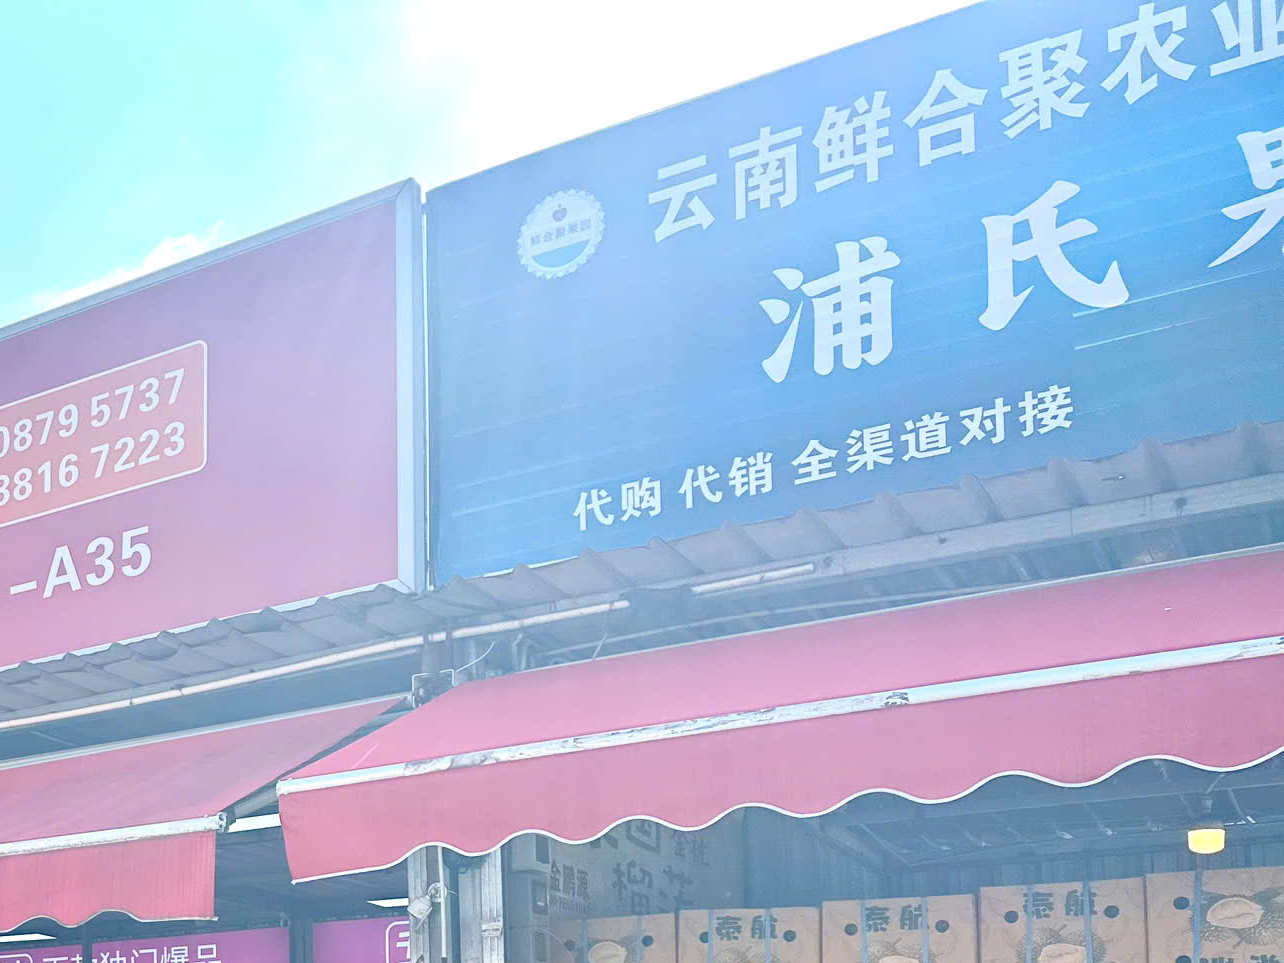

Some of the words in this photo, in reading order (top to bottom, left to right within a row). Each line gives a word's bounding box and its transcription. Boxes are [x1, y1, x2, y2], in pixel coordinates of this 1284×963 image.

[90, 367, 185, 427] 5737
[91, 421, 185, 478] 7223
[573, 476, 662, 531] 代购
[679, 450, 774, 510] 代销
[791, 384, 1074, 486] 全渠道对接
[865, 905, 929, 934] 泰航
[1023, 889, 1097, 920] 泰航
[716, 914, 778, 941] 泰航
